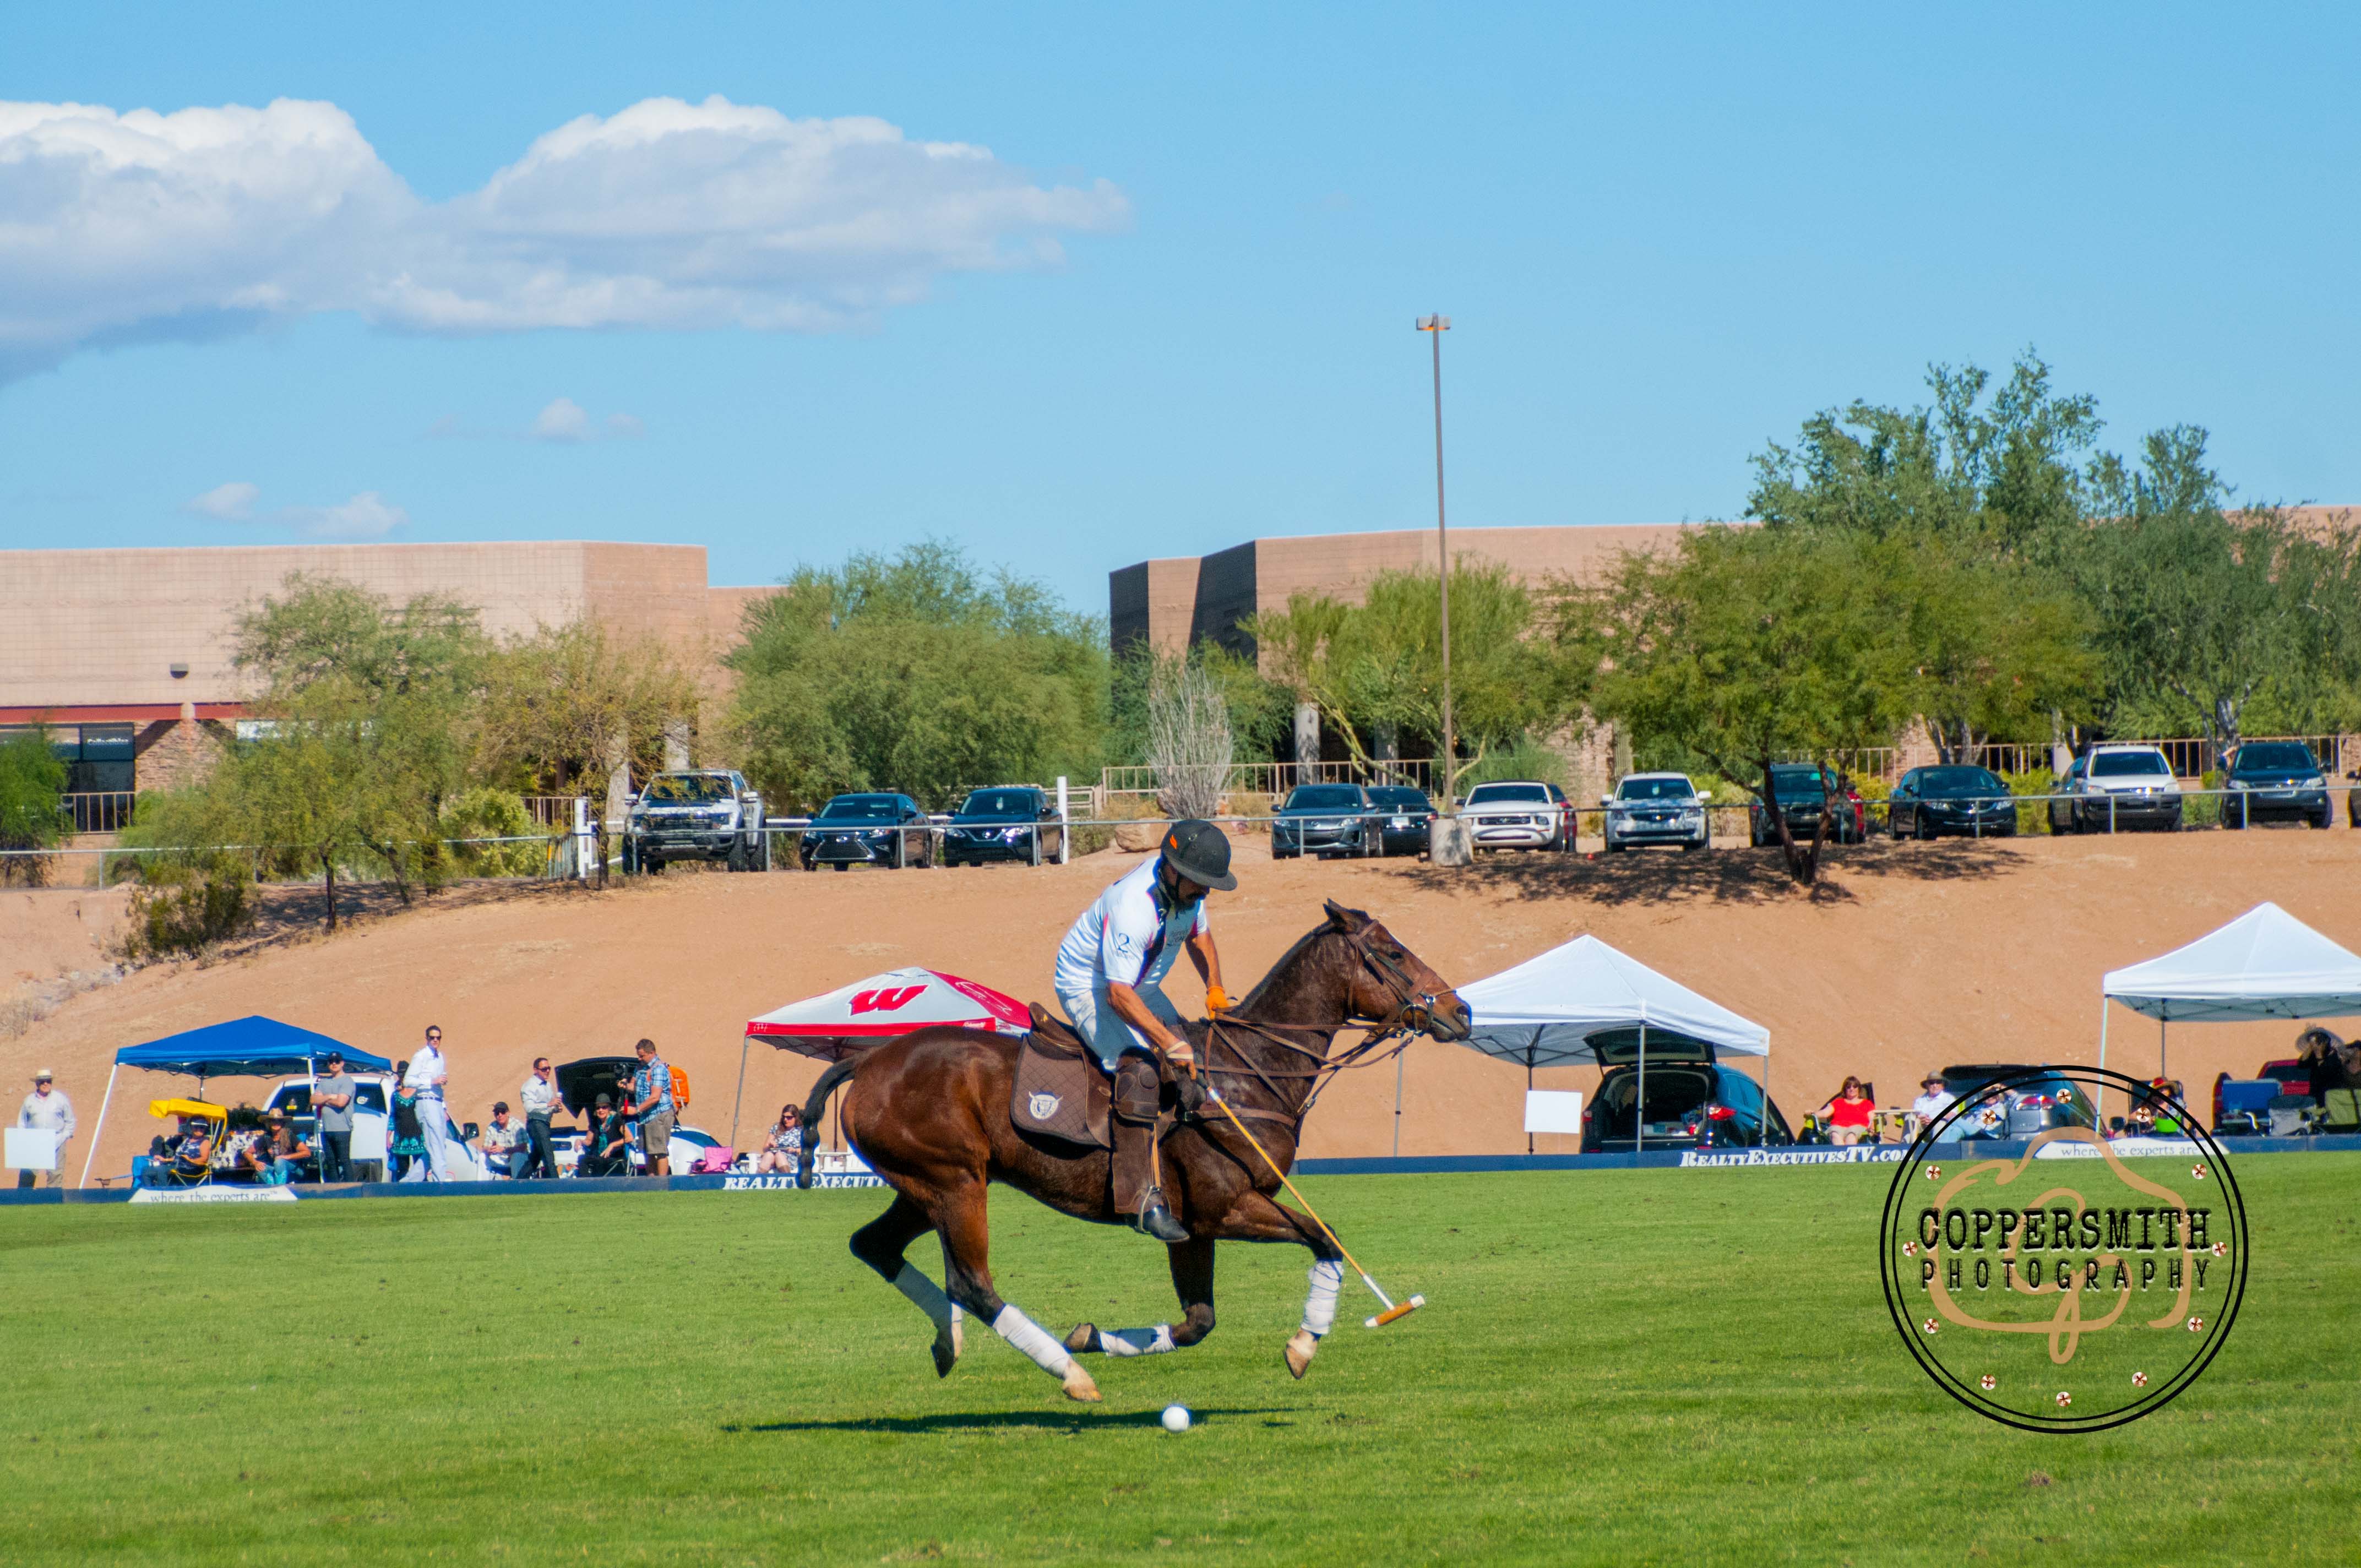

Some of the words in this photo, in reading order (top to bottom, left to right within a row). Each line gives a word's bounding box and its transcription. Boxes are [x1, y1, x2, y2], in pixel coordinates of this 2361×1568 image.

[1118, 933, 1129, 953] 2
[847, 984, 929, 1017] W
[2061, 1144, 2099, 1156] where
[2130, 1146, 2174, 1157] experts
[150, 1192, 184, 1202] where
[190, 1191, 208, 1201] the
[210, 1193, 249, 1204] experts
